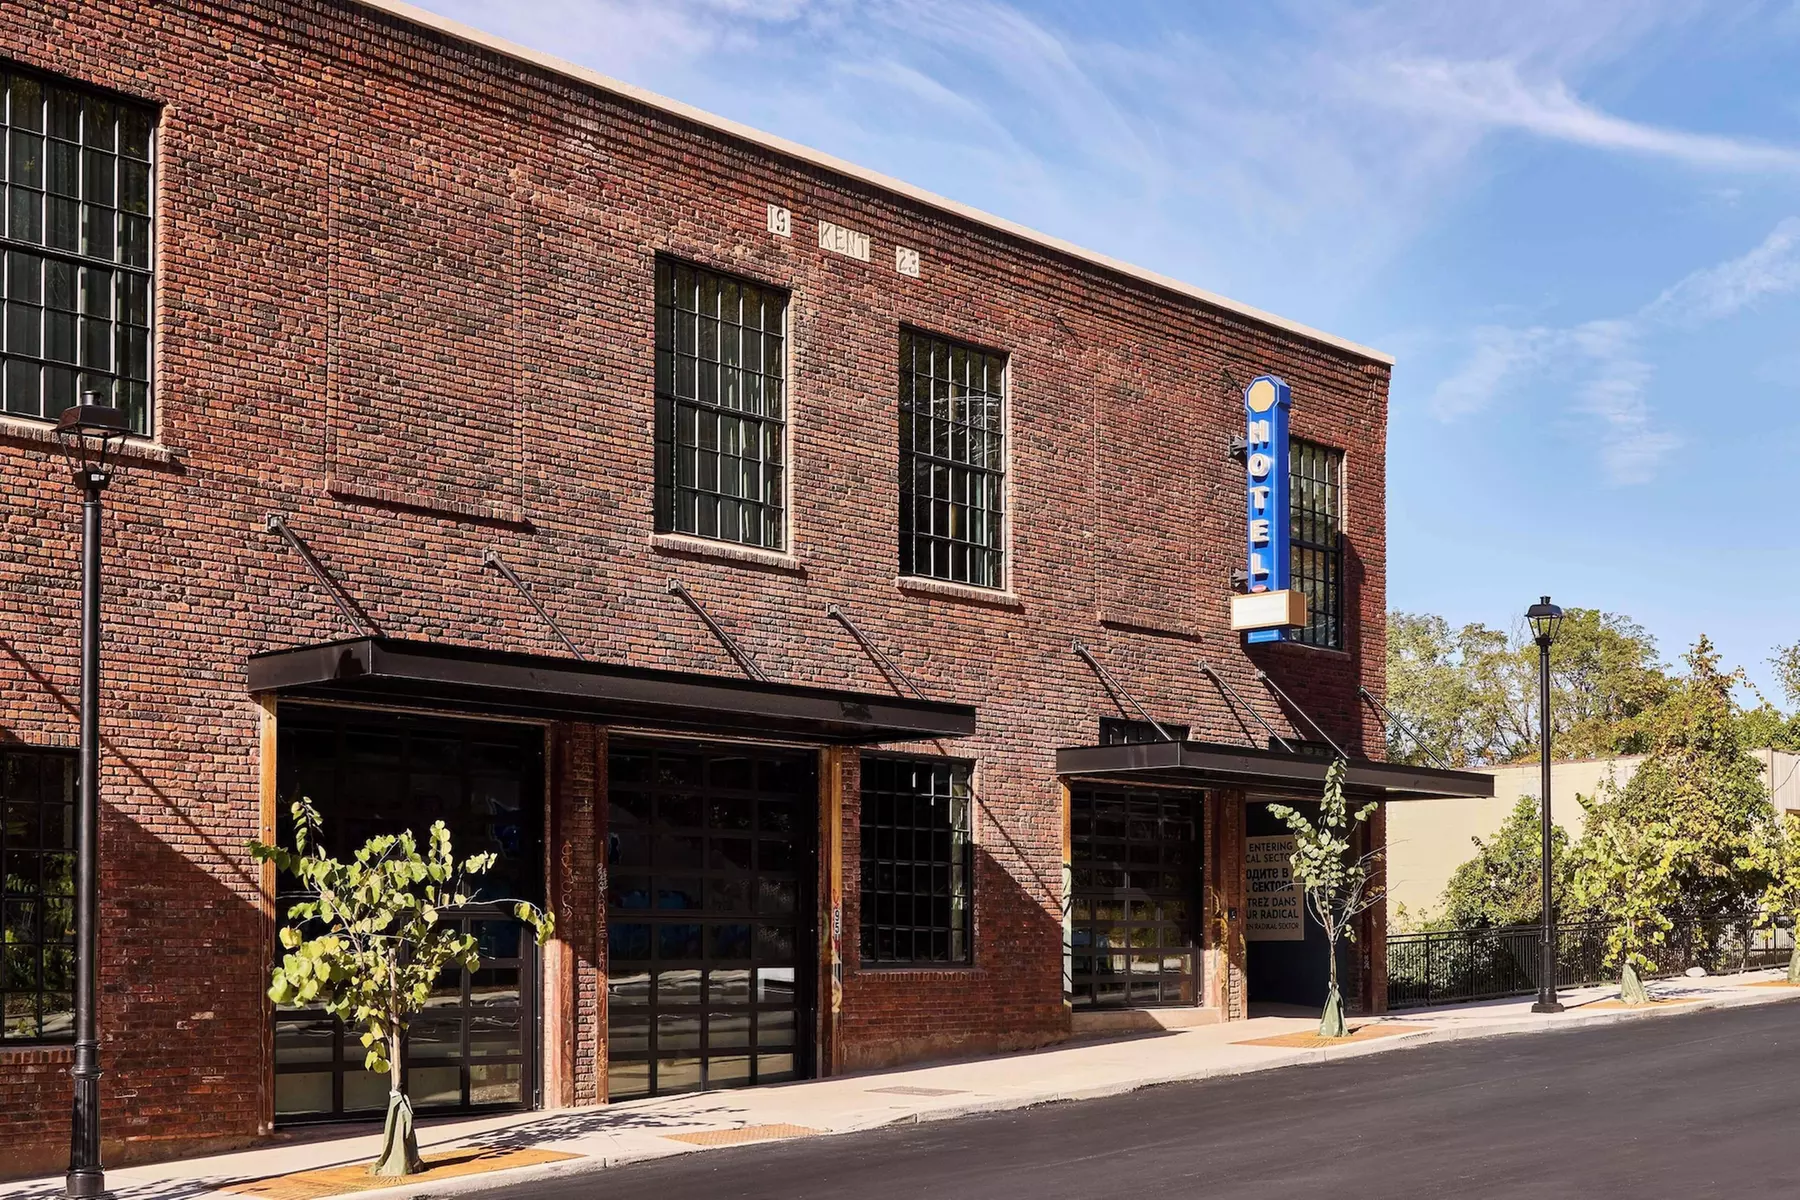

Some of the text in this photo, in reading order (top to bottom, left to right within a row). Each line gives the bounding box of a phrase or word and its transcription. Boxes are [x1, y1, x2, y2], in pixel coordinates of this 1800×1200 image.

[768, 205, 918, 274] 19 KENT 23
[1248, 419, 1271, 576] HOTEL
[1249, 842, 1293, 852] ENTERING
[1264, 853, 1290, 863] SECTO
[1272, 896, 1296, 907] DANS
[1260, 909, 1299, 919] RADICAL
